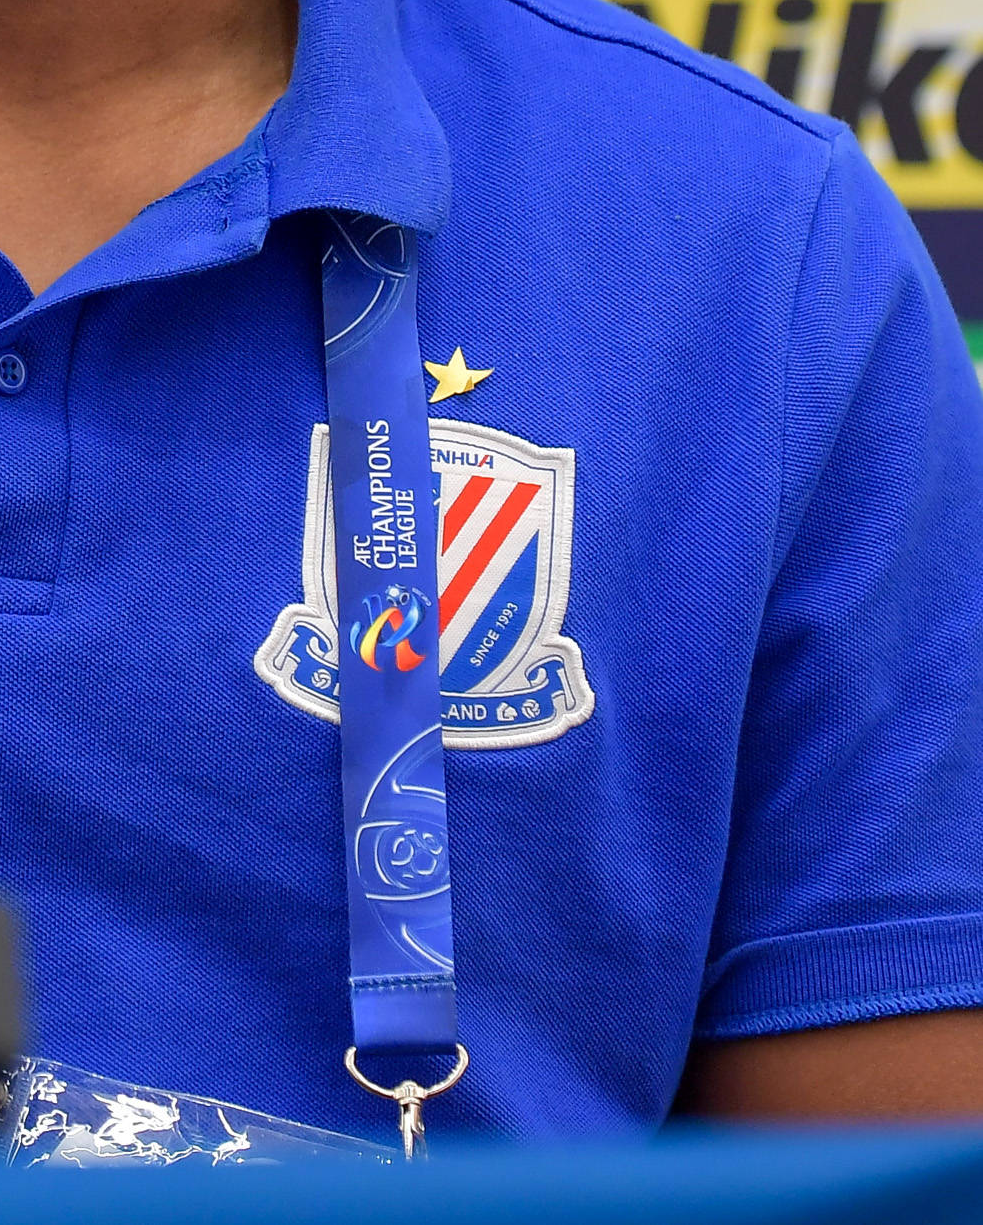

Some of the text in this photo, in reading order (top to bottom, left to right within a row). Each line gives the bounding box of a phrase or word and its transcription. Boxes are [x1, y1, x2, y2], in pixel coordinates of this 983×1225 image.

[365, 419, 397, 570] CHAMPIONS
[394, 489, 418, 570] LEAGUE
[353, 535, 372, 569] AFC
[469, 602, 519, 667] SINCE 1993
